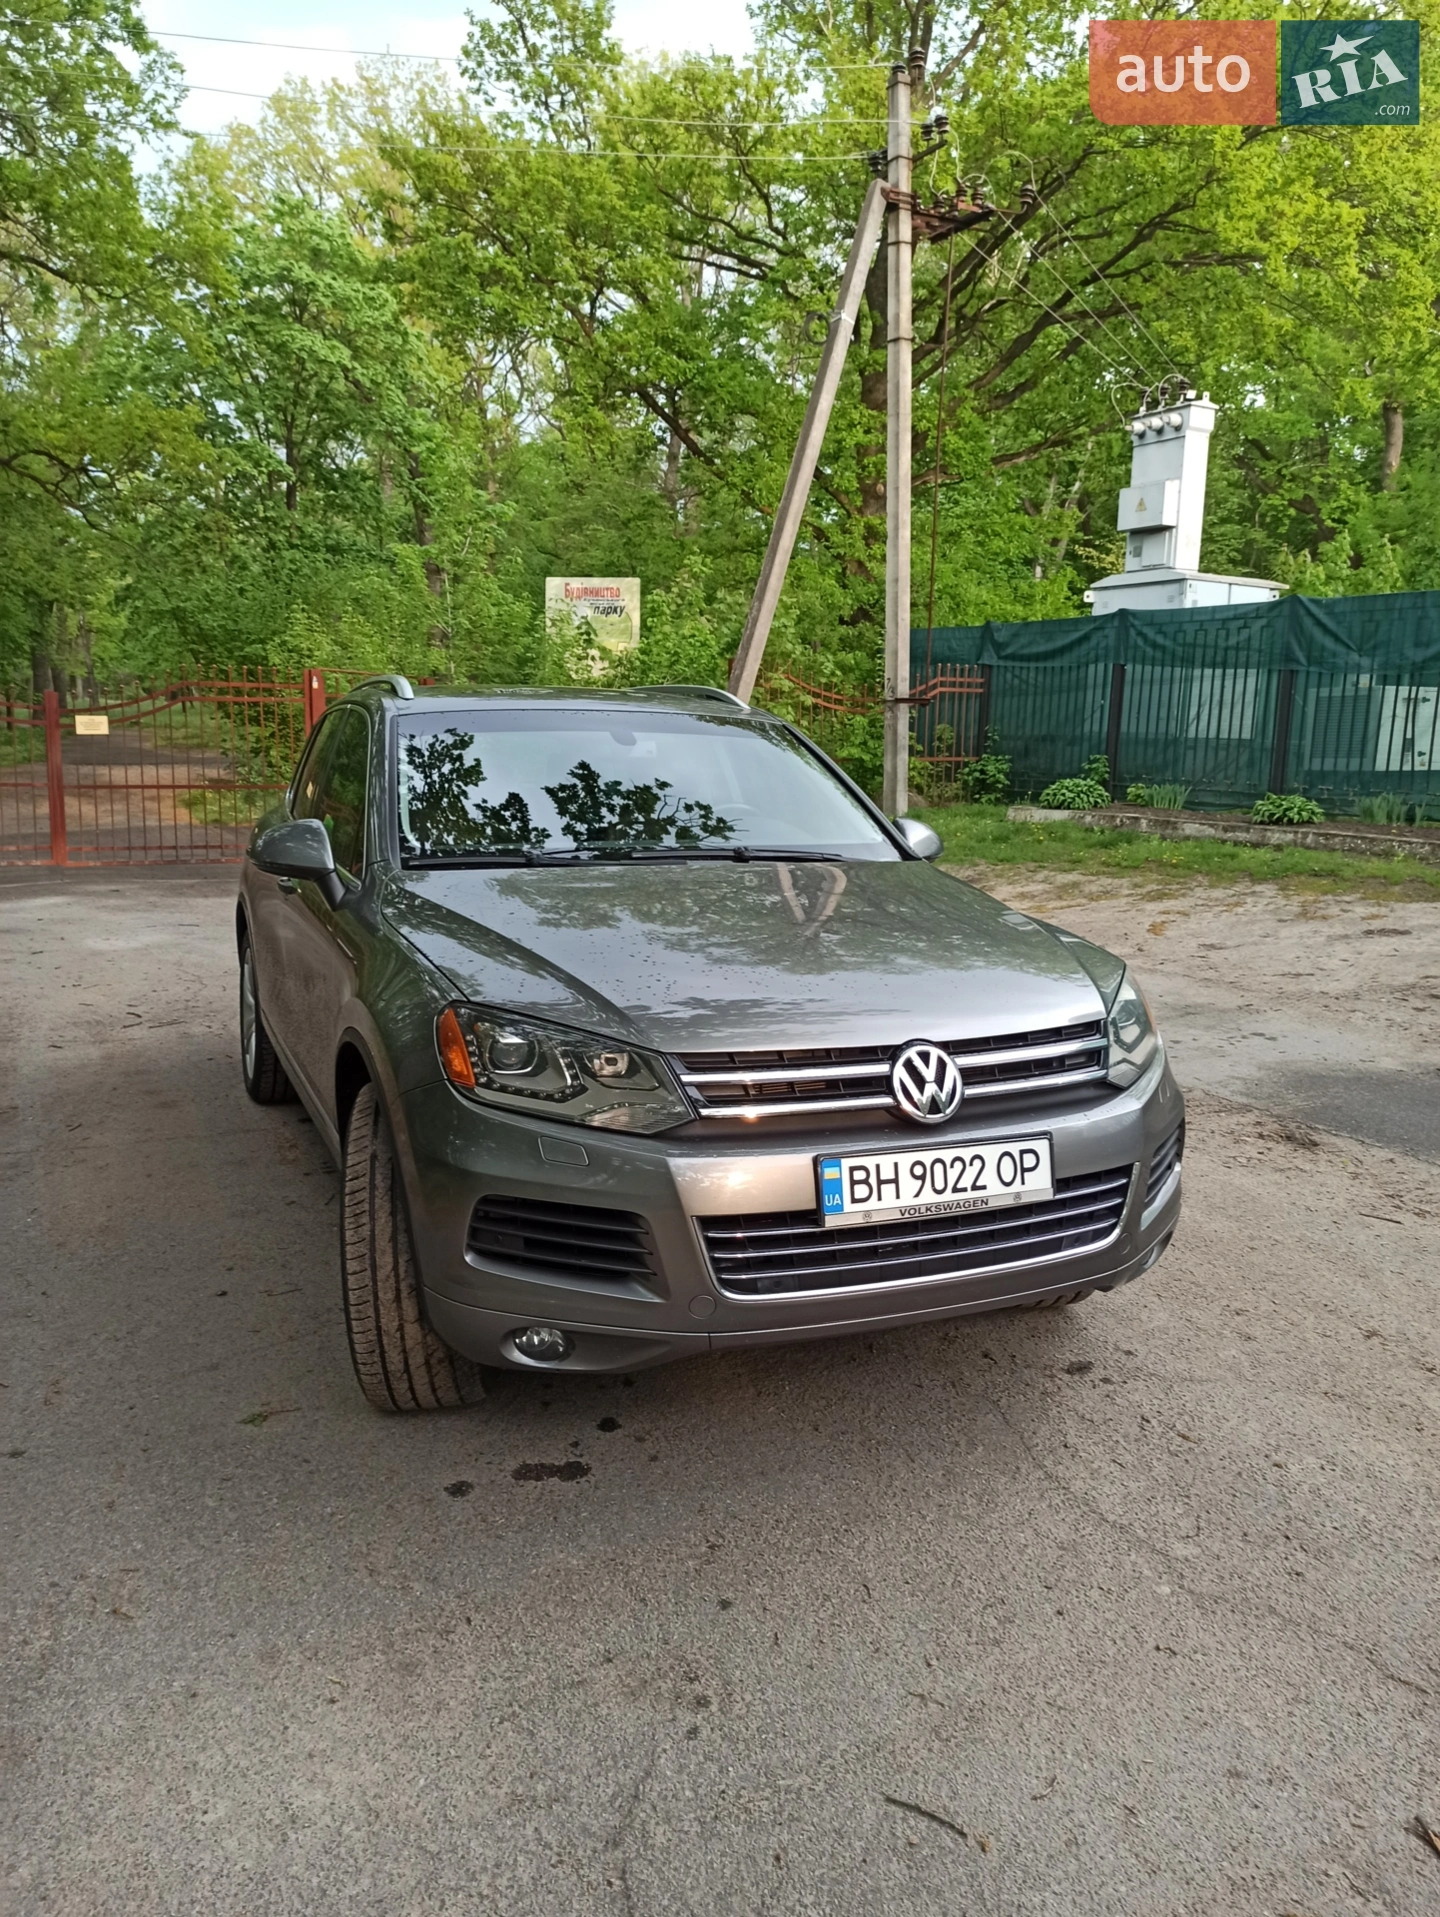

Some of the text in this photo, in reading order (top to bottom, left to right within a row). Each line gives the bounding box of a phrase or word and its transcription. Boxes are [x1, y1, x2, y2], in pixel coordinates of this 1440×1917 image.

[564, 582, 620, 601] Будівництво
[593, 605, 625, 617] парку
[848, 1148, 1040, 1204] BH 9022 OP
[825, 1196, 842, 1207] UA
[899, 1198, 989, 1217] VOLKSWAGEN
